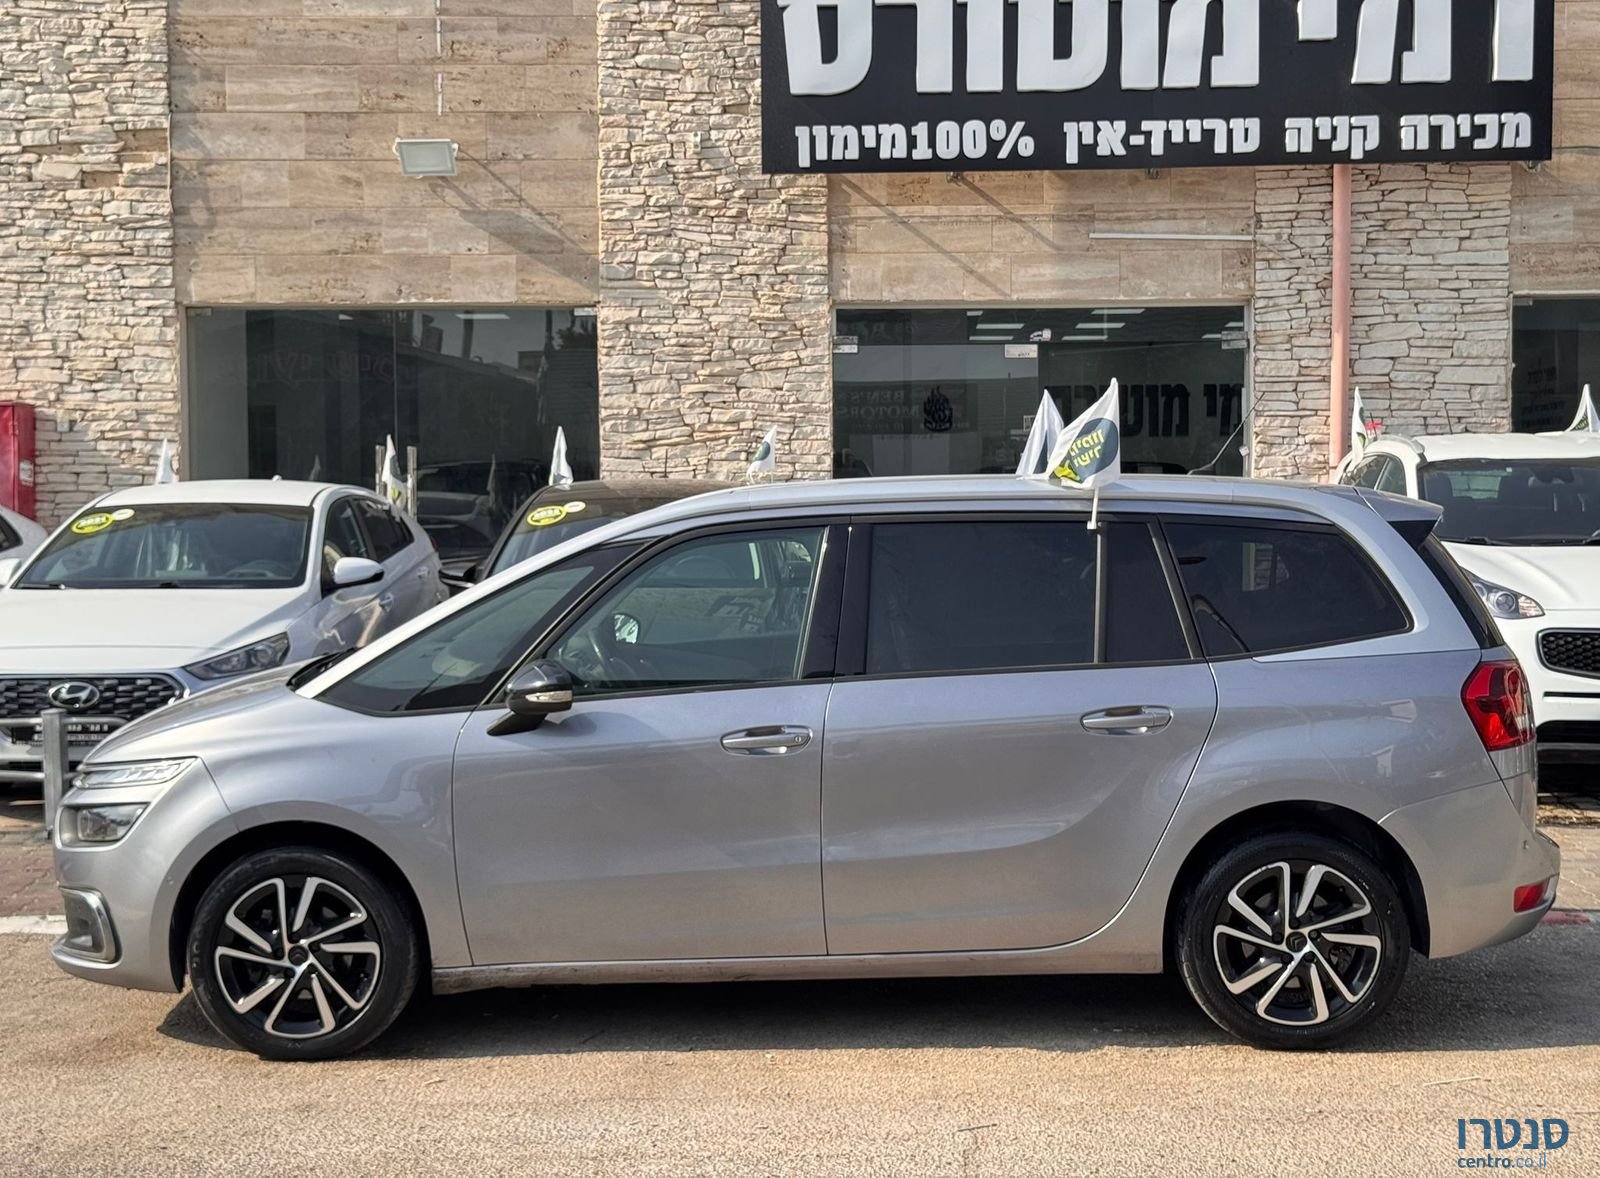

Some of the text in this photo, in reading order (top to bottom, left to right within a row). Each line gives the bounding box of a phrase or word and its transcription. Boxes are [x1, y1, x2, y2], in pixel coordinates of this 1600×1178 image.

[1063, 117, 1261, 165] טרייד-אין
[1284, 114, 1380, 160] קניה
[1400, 112, 1532, 151] מכירה
